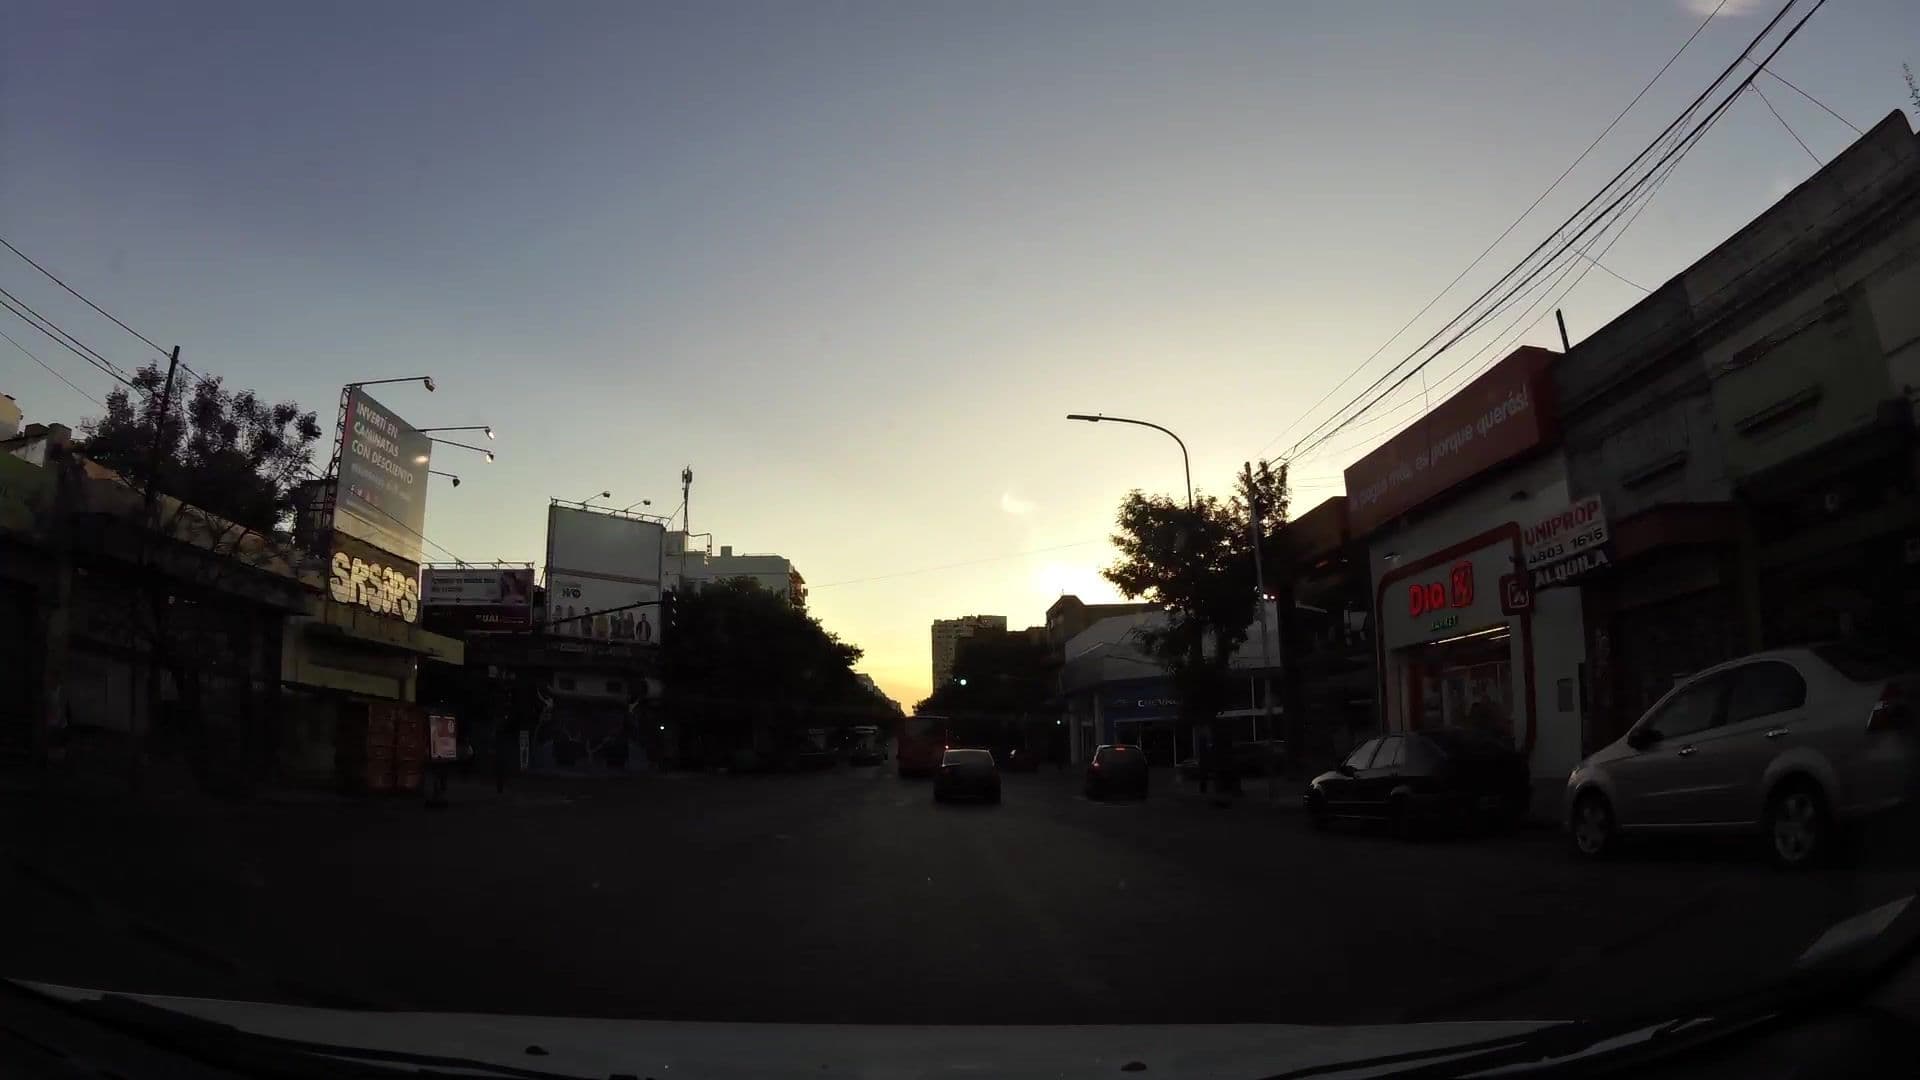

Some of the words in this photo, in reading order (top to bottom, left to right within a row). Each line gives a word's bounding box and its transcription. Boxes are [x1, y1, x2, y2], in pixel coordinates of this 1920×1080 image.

[354, 421, 400, 457] CAMINATAS
[386, 423, 399, 439] EN
[352, 439, 372, 459] CON
[371, 451, 414, 485] DESCUENTO
[1524, 500, 1598, 545] UNIPROP
[1535, 549, 1609, 588] ALQUILA
